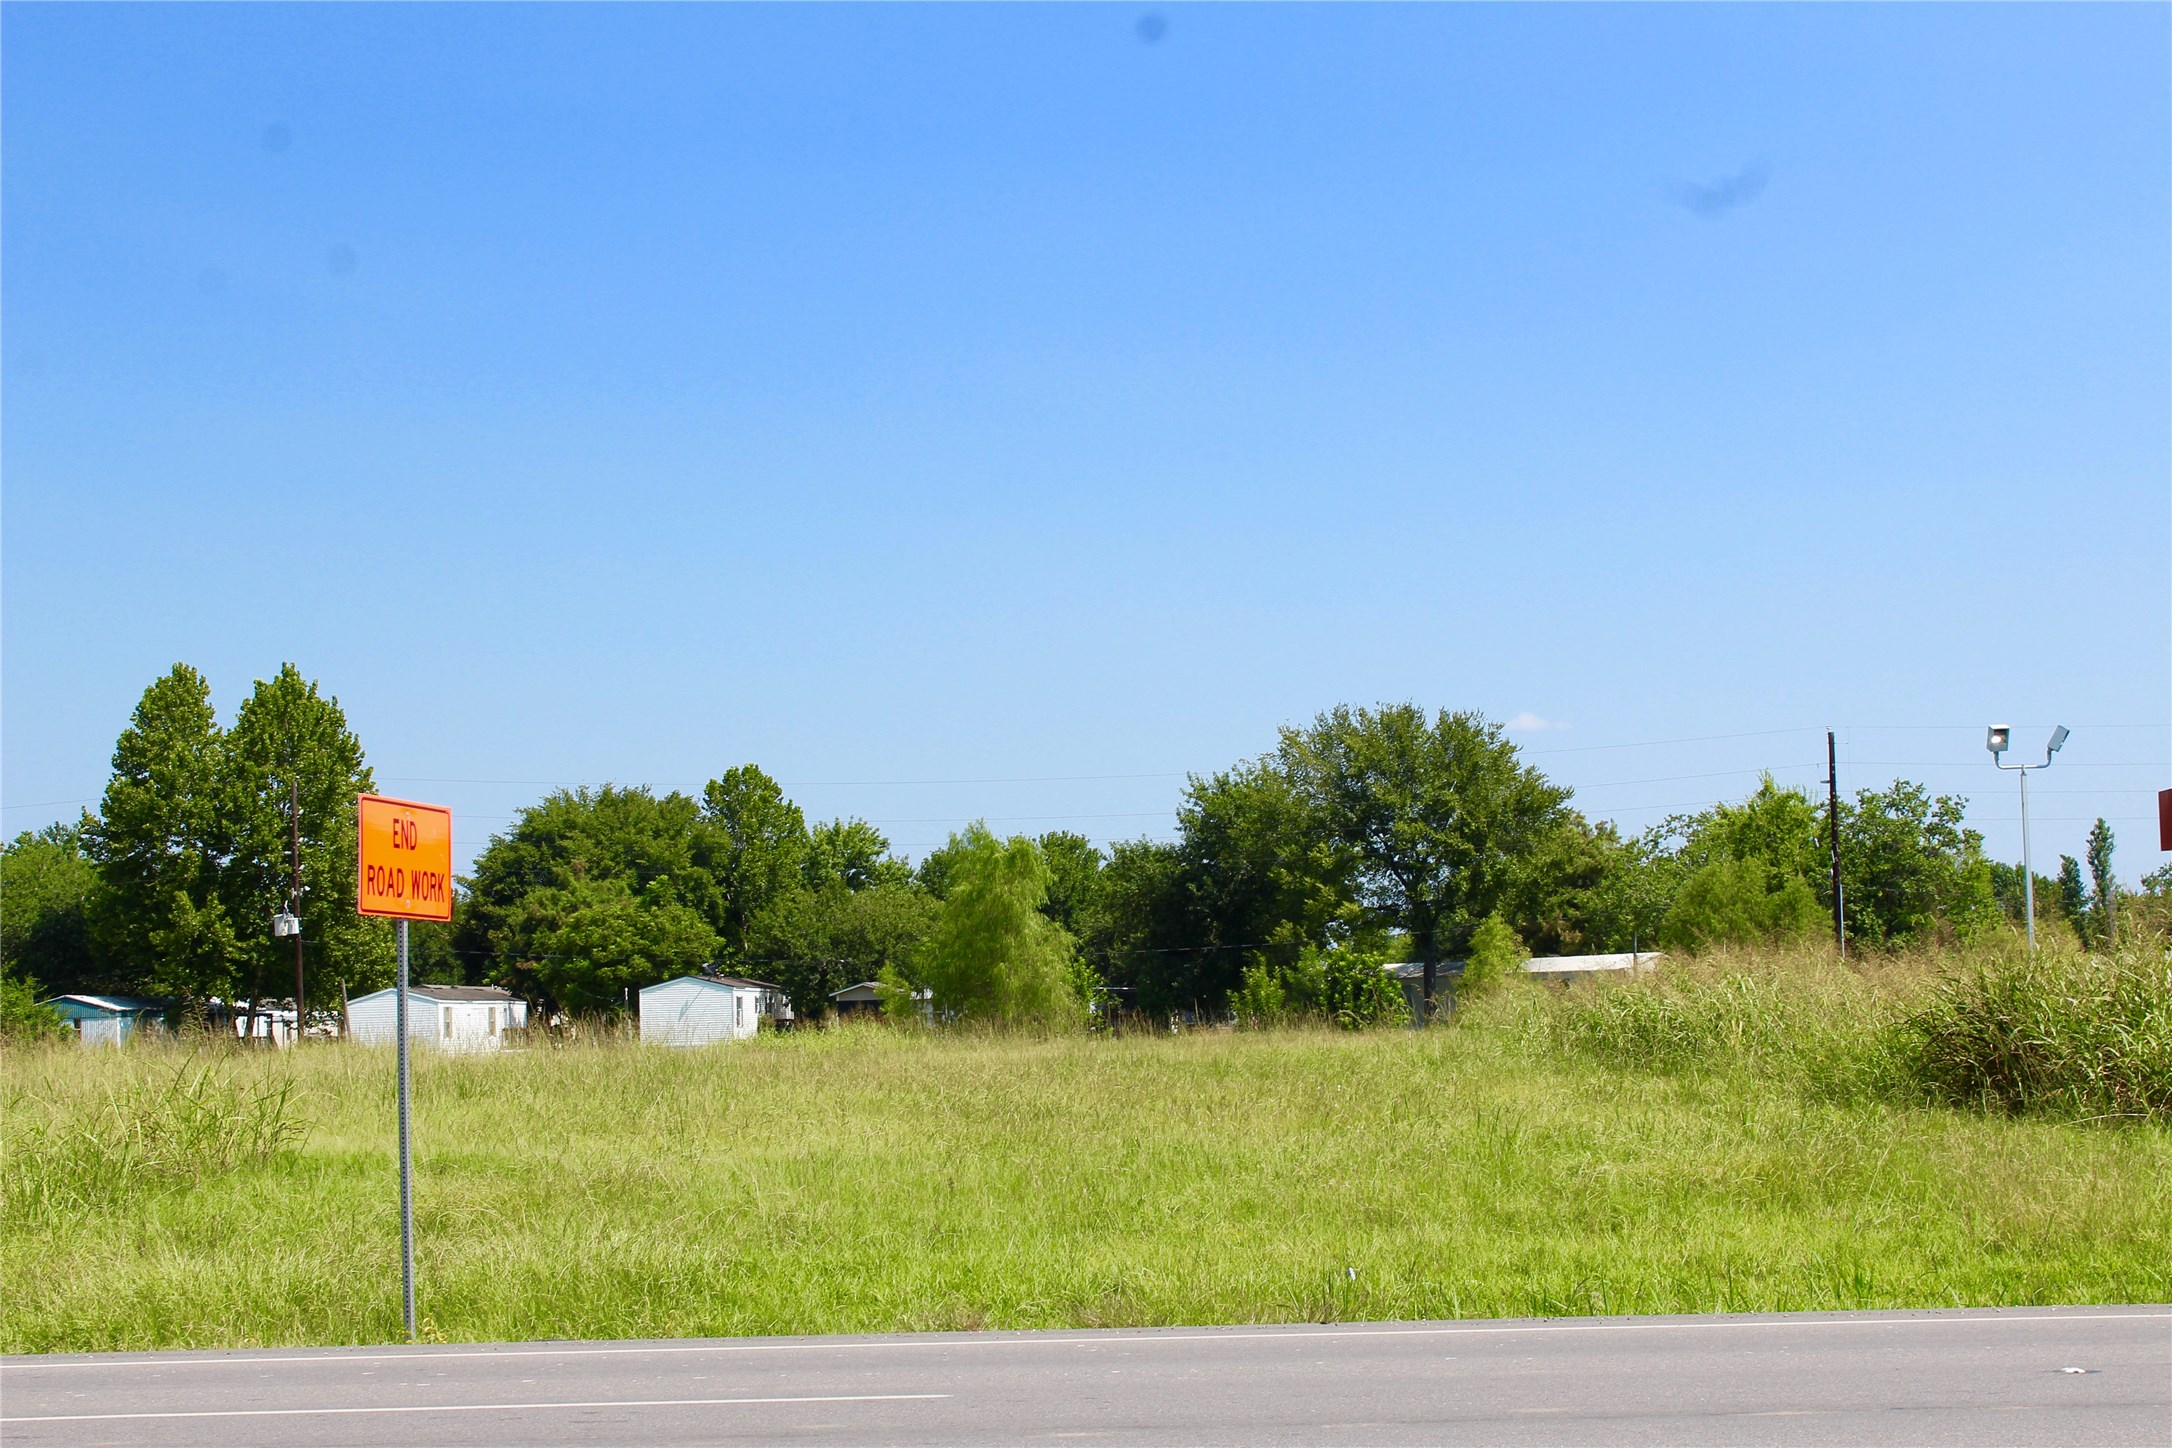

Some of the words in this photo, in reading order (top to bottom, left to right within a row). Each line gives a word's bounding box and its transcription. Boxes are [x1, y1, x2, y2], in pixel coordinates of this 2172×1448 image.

[393, 818, 417, 850] END
[367, 864, 404, 898] ROAD
[411, 869, 445, 903] WORK
